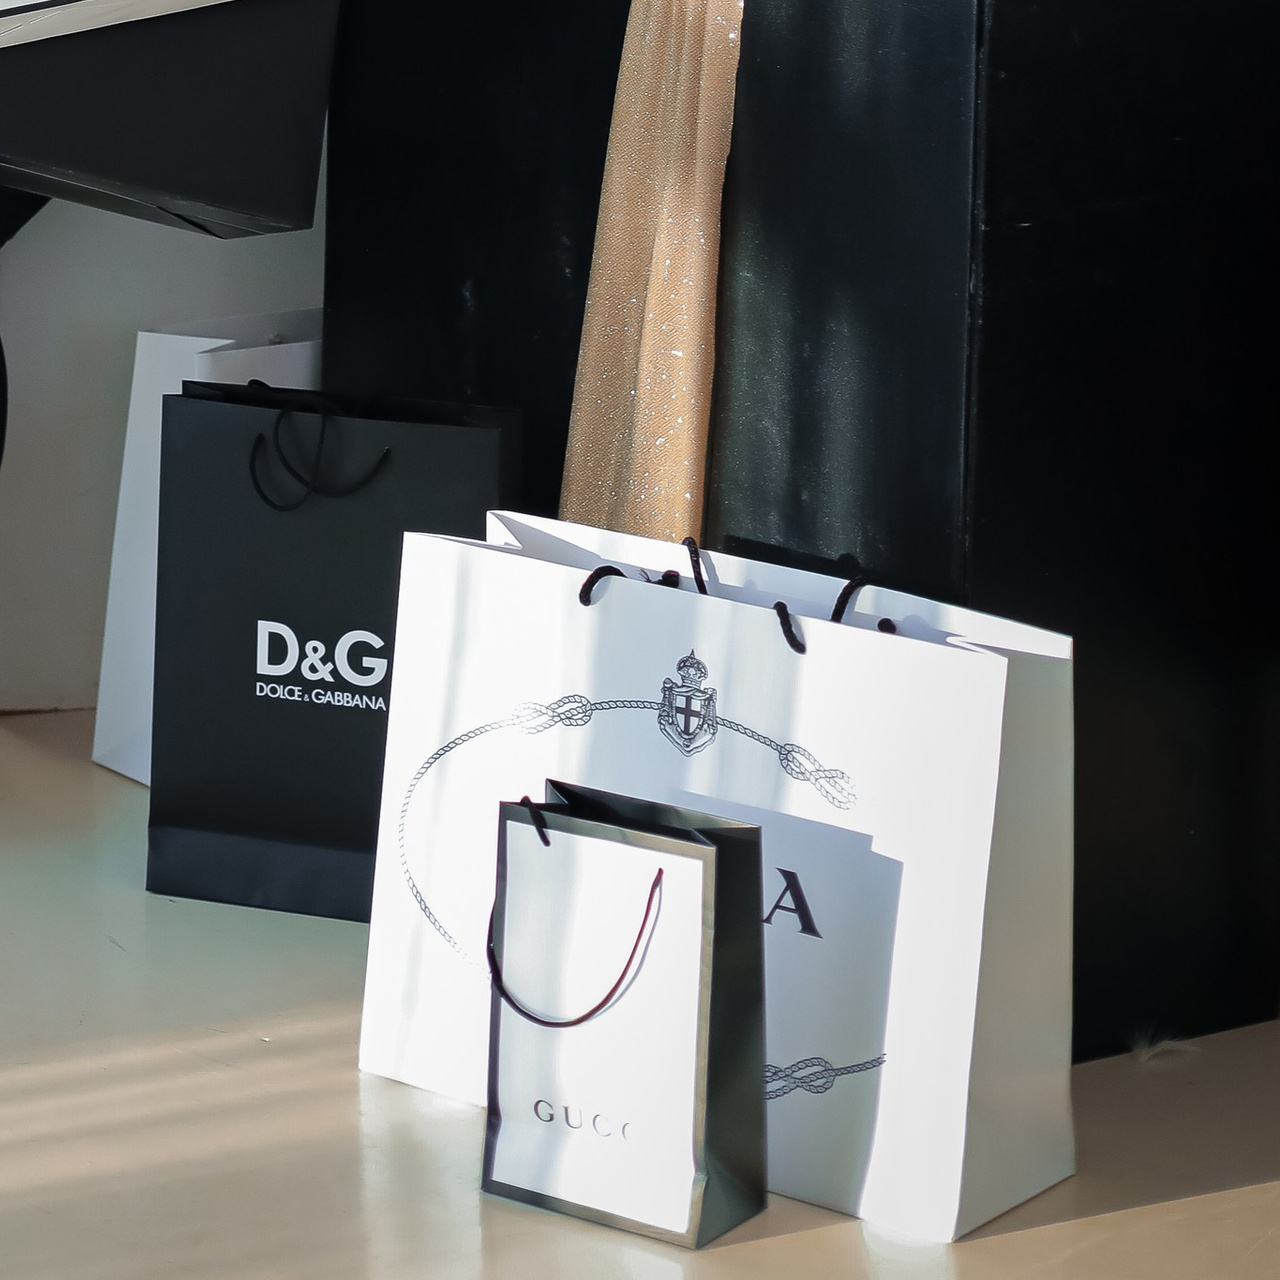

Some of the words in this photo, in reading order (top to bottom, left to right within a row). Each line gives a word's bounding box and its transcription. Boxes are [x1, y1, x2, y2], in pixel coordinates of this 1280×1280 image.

[256, 619, 389, 687] D&G
[255, 682, 303, 701] DOLCE
[311, 689, 387, 711] GABBANA
